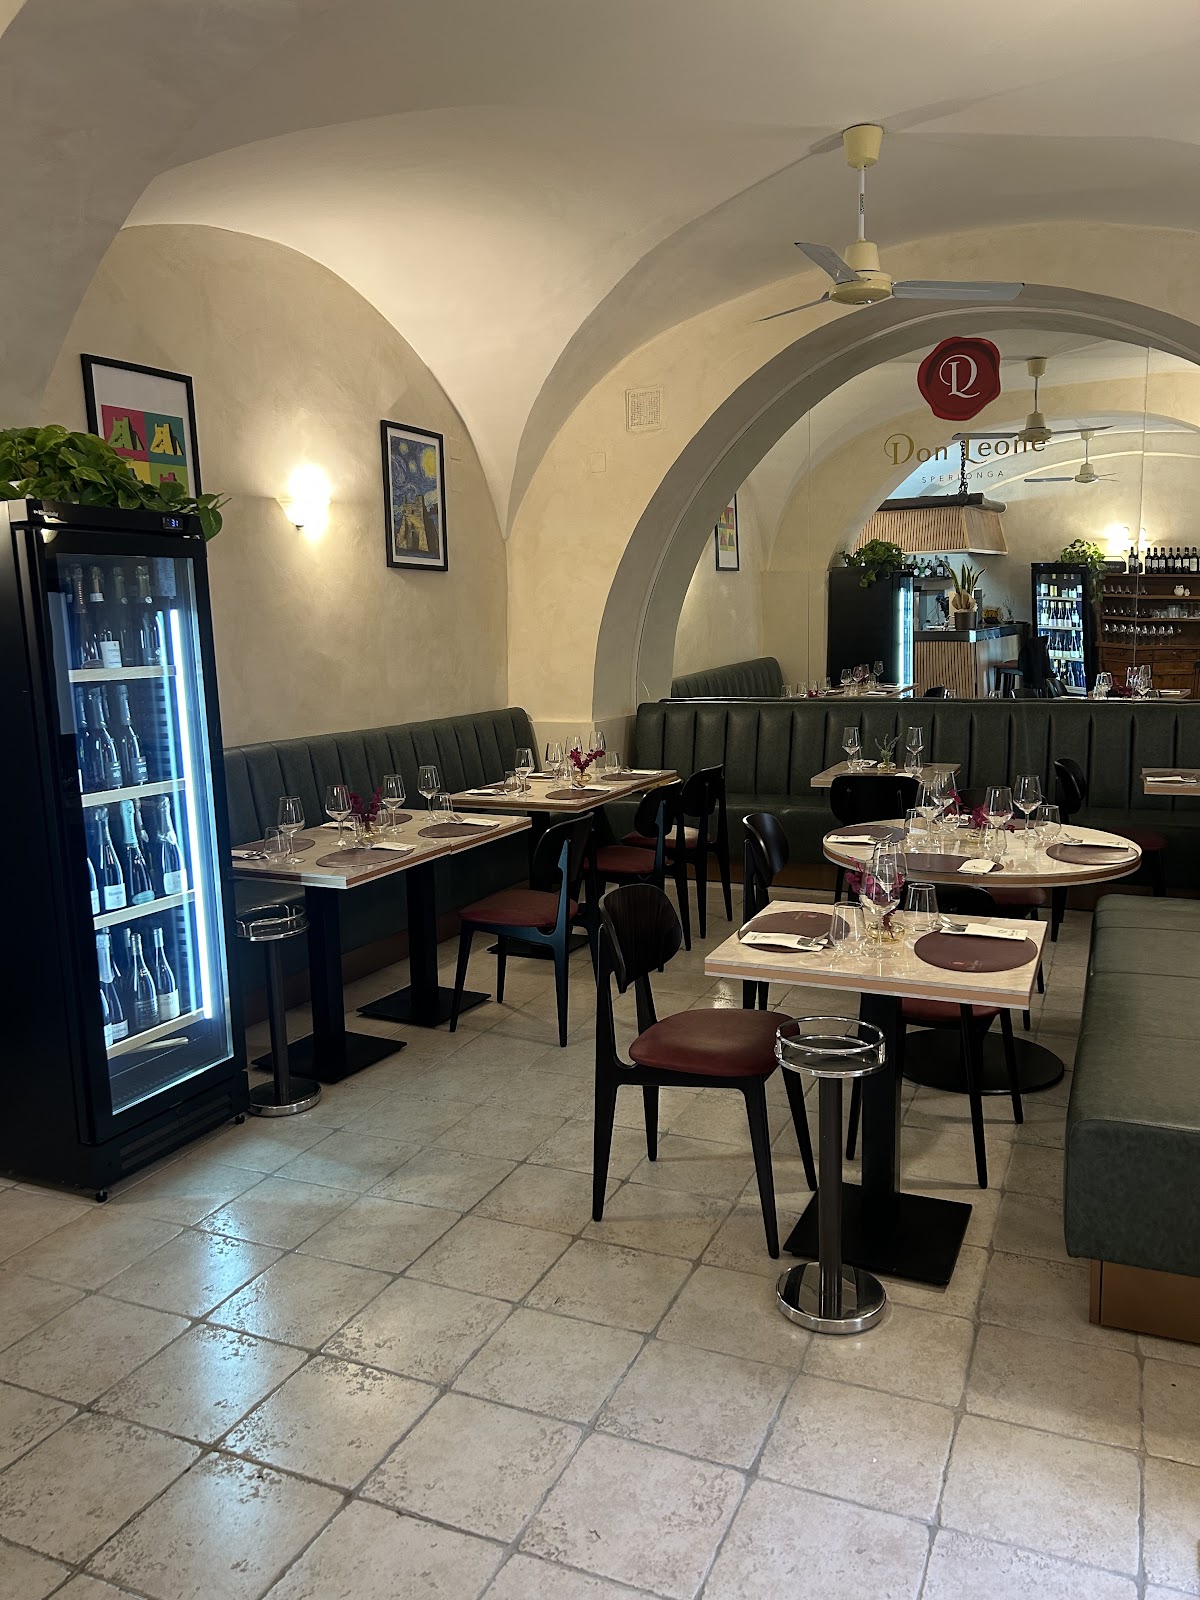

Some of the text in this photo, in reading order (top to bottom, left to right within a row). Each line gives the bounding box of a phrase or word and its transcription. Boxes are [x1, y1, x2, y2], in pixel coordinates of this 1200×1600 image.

[884, 433, 1046, 465] Don Leone
[921, 470, 1004, 483] SPERLONGA
